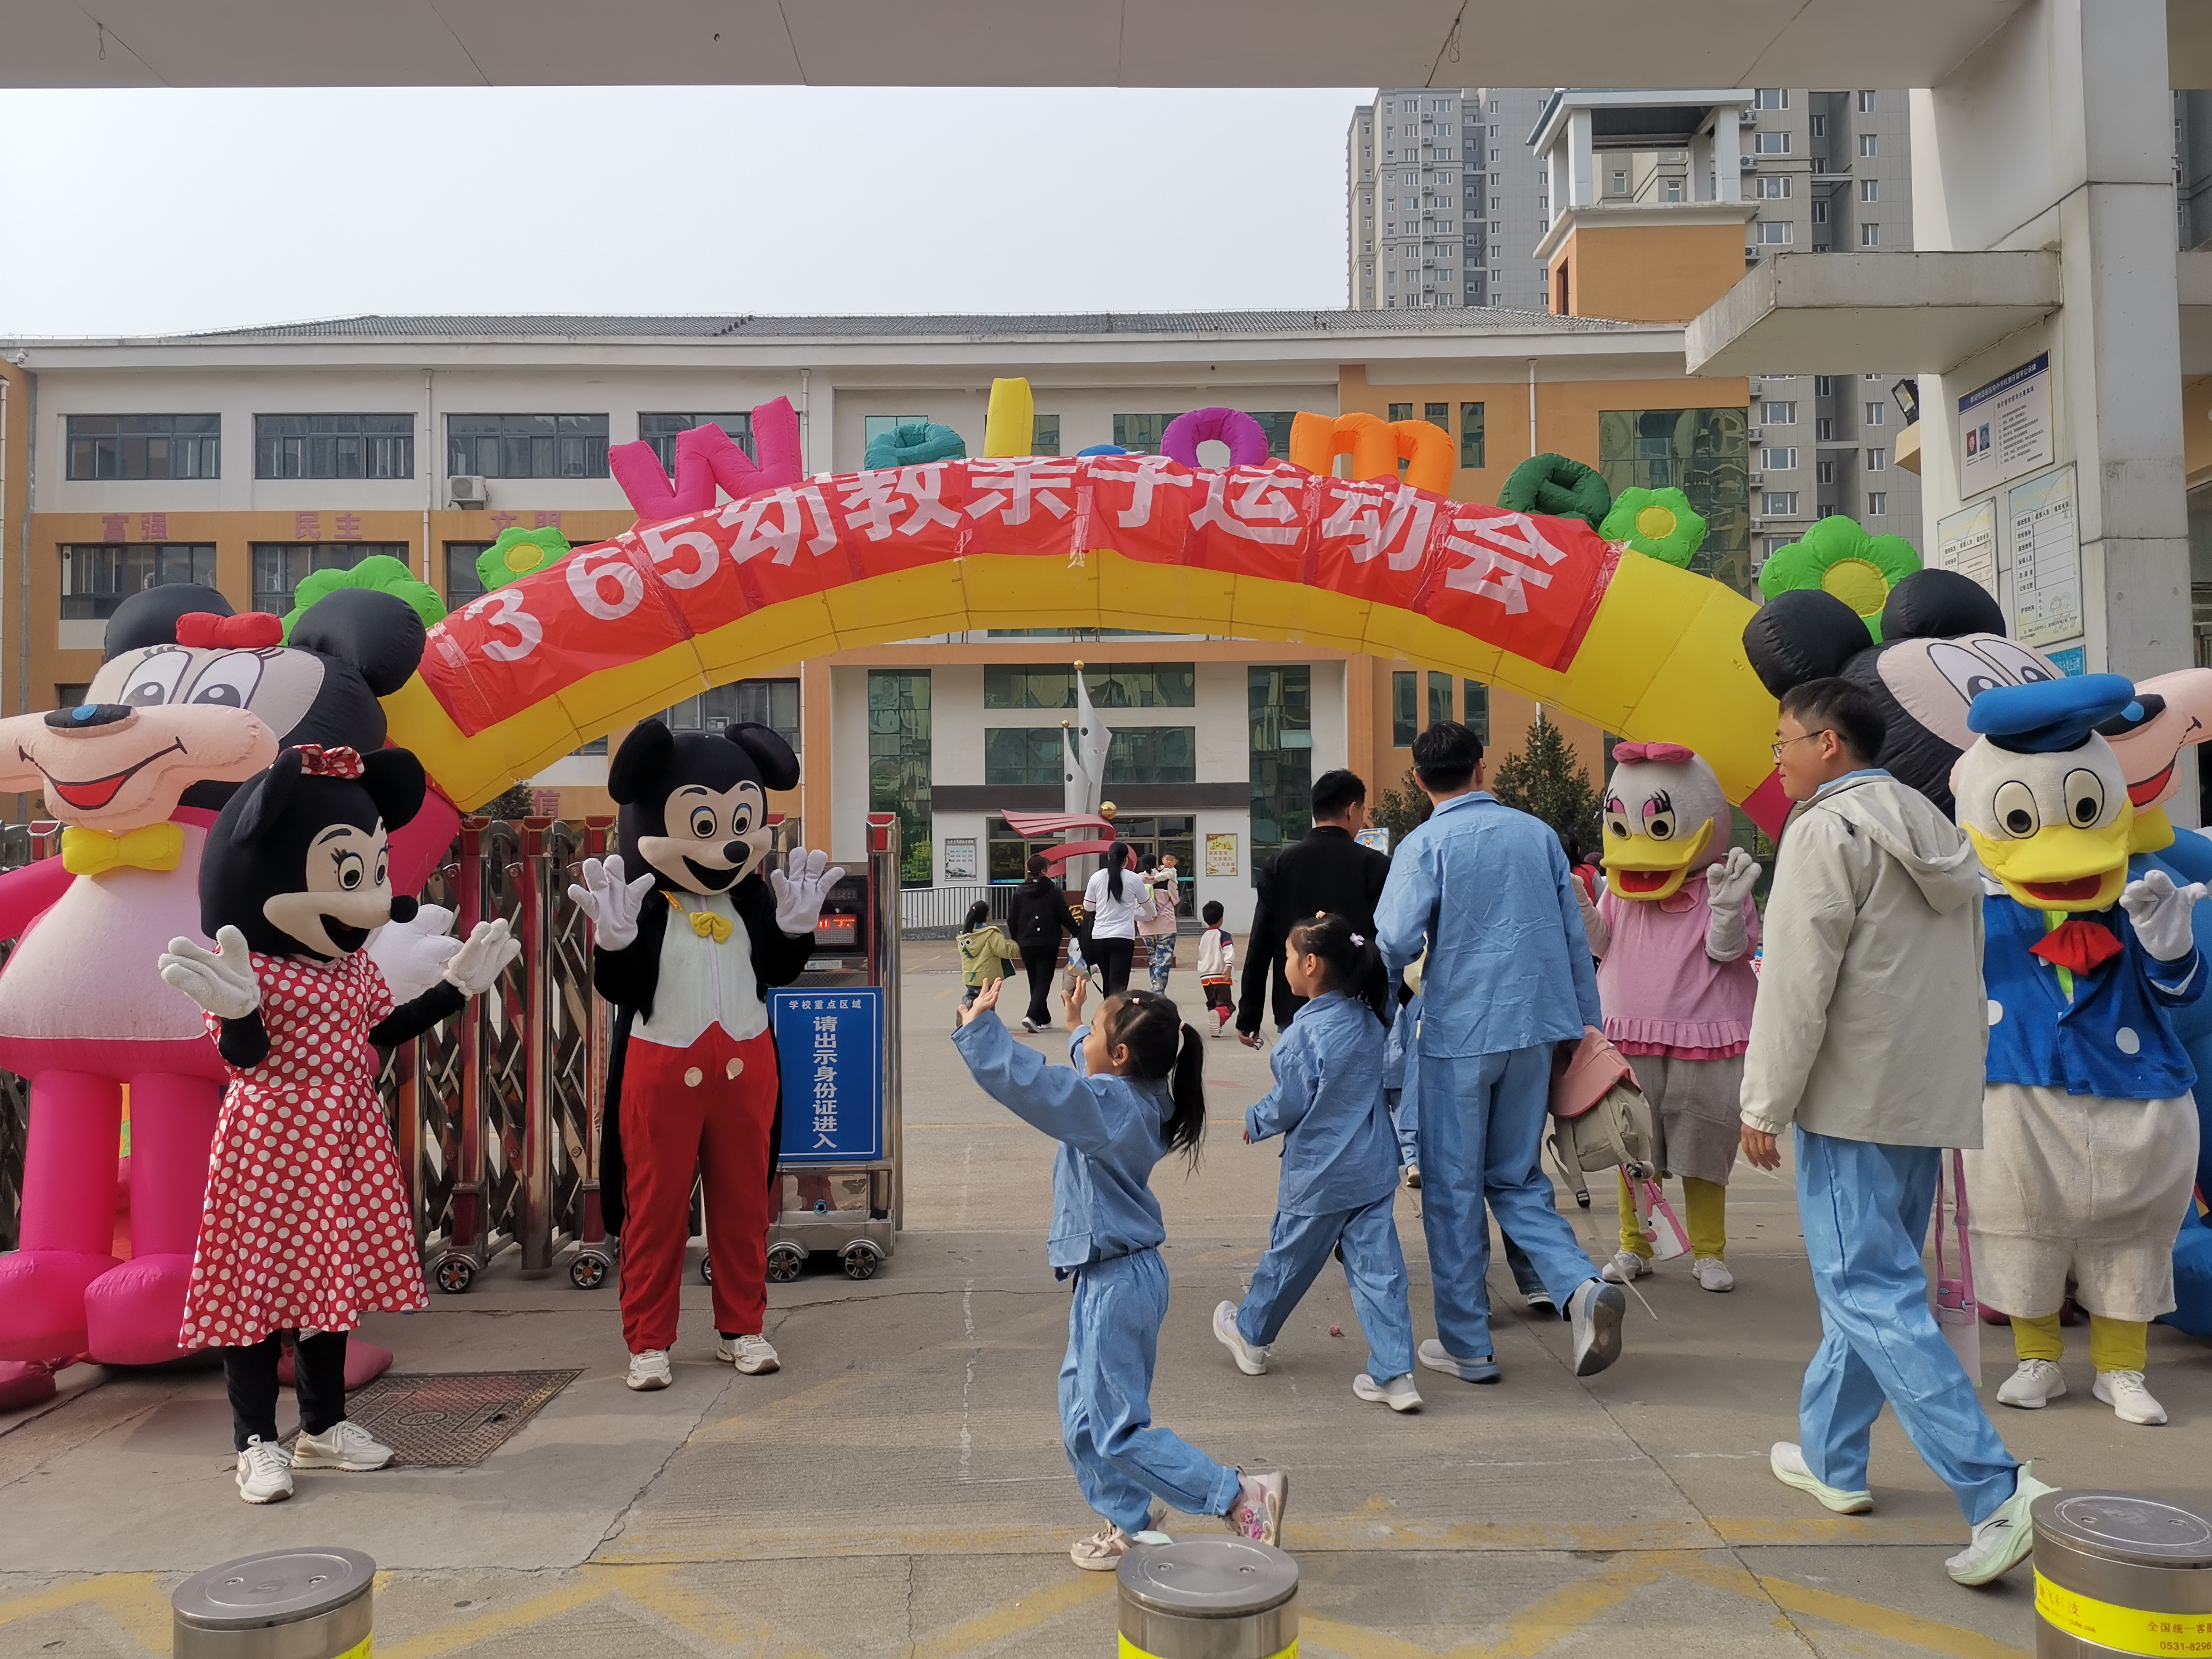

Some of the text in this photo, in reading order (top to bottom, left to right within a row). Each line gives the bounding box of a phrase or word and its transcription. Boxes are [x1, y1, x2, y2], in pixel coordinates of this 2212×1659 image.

[608, 377, 1612, 533] Welome
[102, 513, 168, 541] 富强
[295, 511, 362, 540] 民主
[490, 510, 561, 540] 文明
[464, 457, 1568, 662] 365幼教亲子运动会
[789, 998, 862, 1010] 学校重点区域
[812, 1015, 838, 1149] 请出示身份证进入
